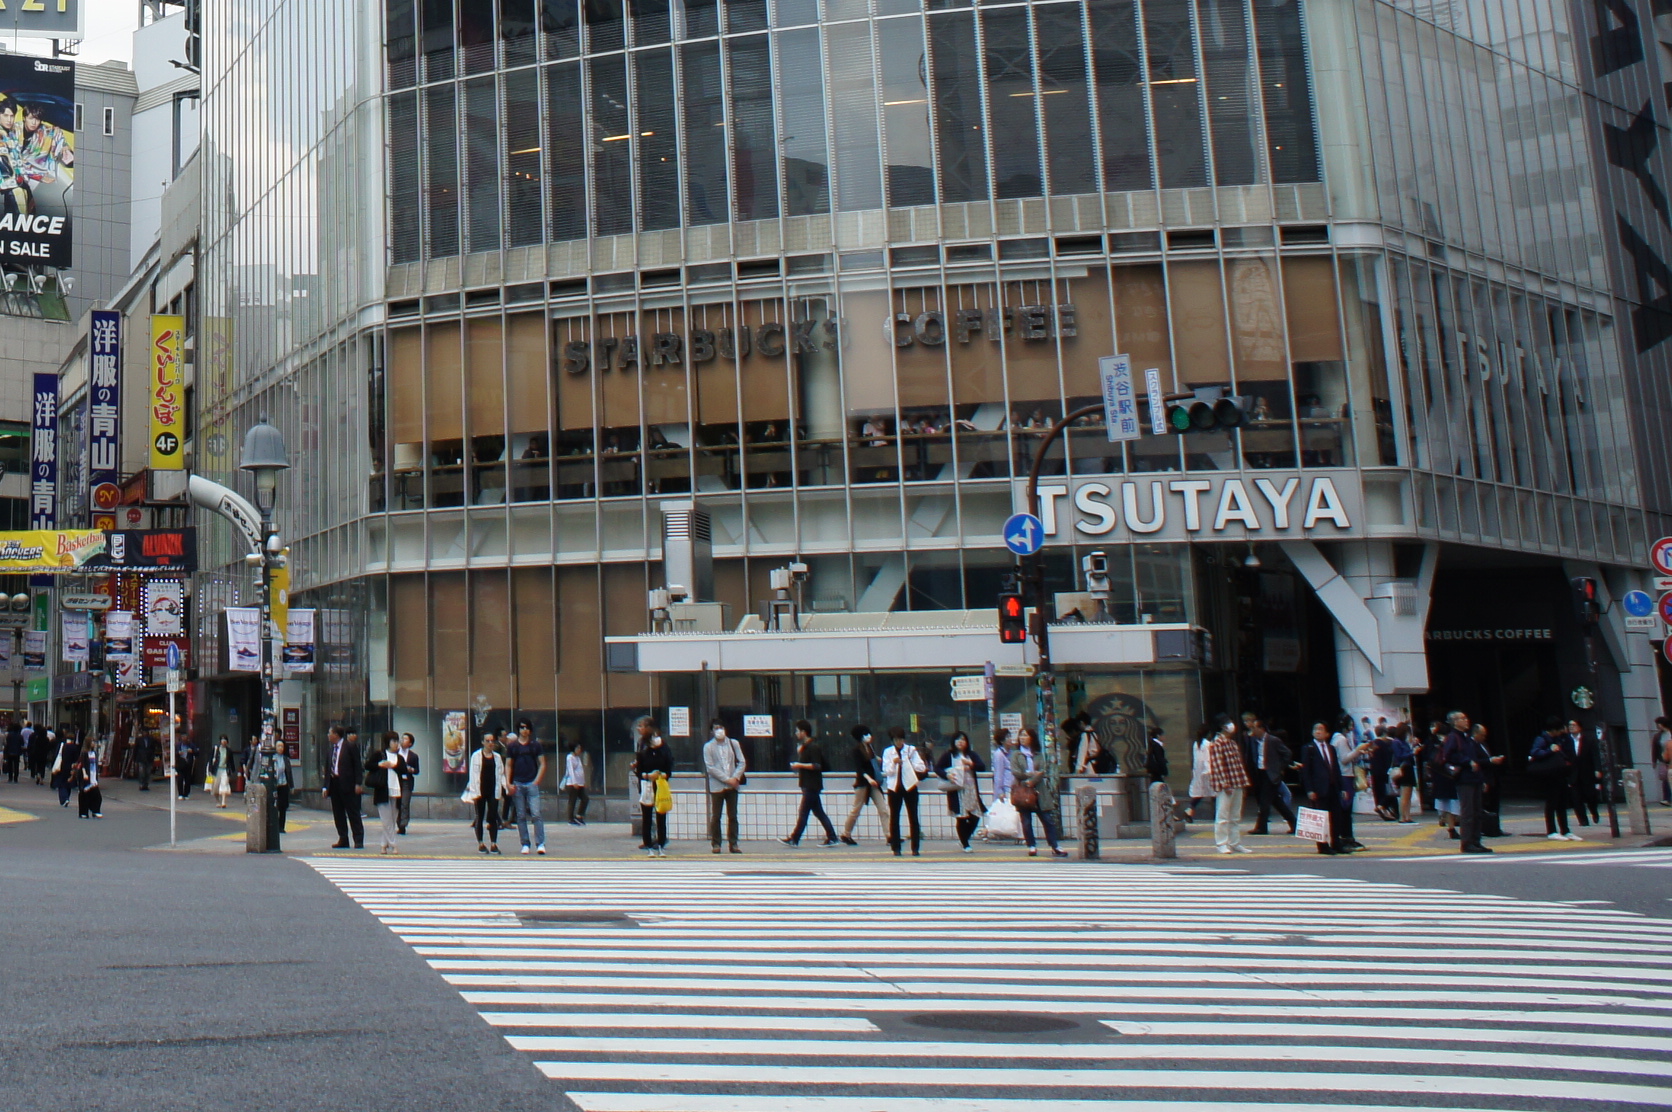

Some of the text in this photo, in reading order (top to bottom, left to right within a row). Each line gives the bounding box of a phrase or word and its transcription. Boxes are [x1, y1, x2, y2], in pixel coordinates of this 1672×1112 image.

[9, 241, 51, 258] SALE
[562, 315, 851, 376] STARBUCKS
[882, 303, 1078, 347] COFFEE
[91, 318, 119, 471] 洋服の青山
[153, 329, 180, 426] くいしんぼ
[156, 435, 176, 452] 4F
[1035, 477, 1352, 536] TSUTAYA
[1494, 628, 1552, 639] COFFEE
